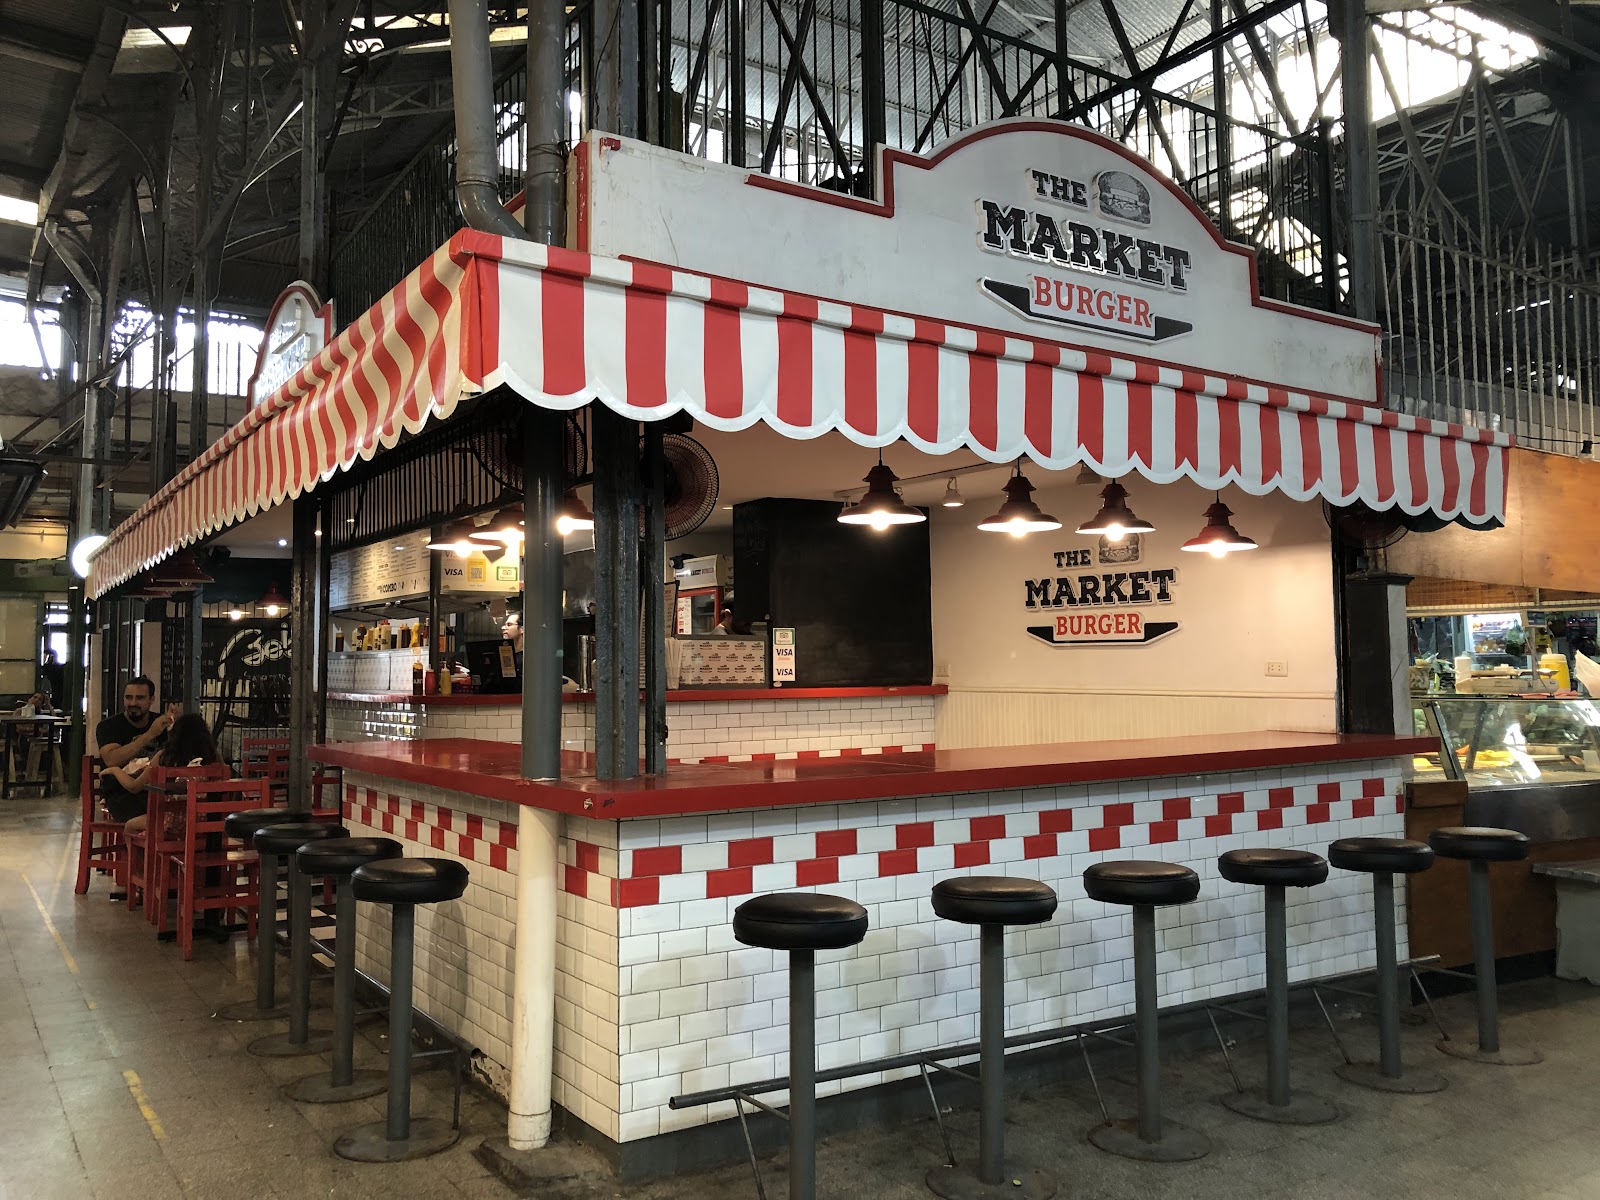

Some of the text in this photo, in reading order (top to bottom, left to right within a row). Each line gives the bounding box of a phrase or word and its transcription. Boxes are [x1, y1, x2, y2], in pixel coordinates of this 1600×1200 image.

[1031, 169, 1088, 207] THE
[982, 200, 1191, 291] MARKET
[1033, 275, 1152, 328] BURGER
[1054, 549, 1091, 568] THE
[444, 568, 463, 576] VISA
[1025, 569, 1176, 609] MARKET
[1056, 613, 1142, 636] BURGER
[776, 648, 793, 656] VISA
[776, 668, 793, 676] VISA
